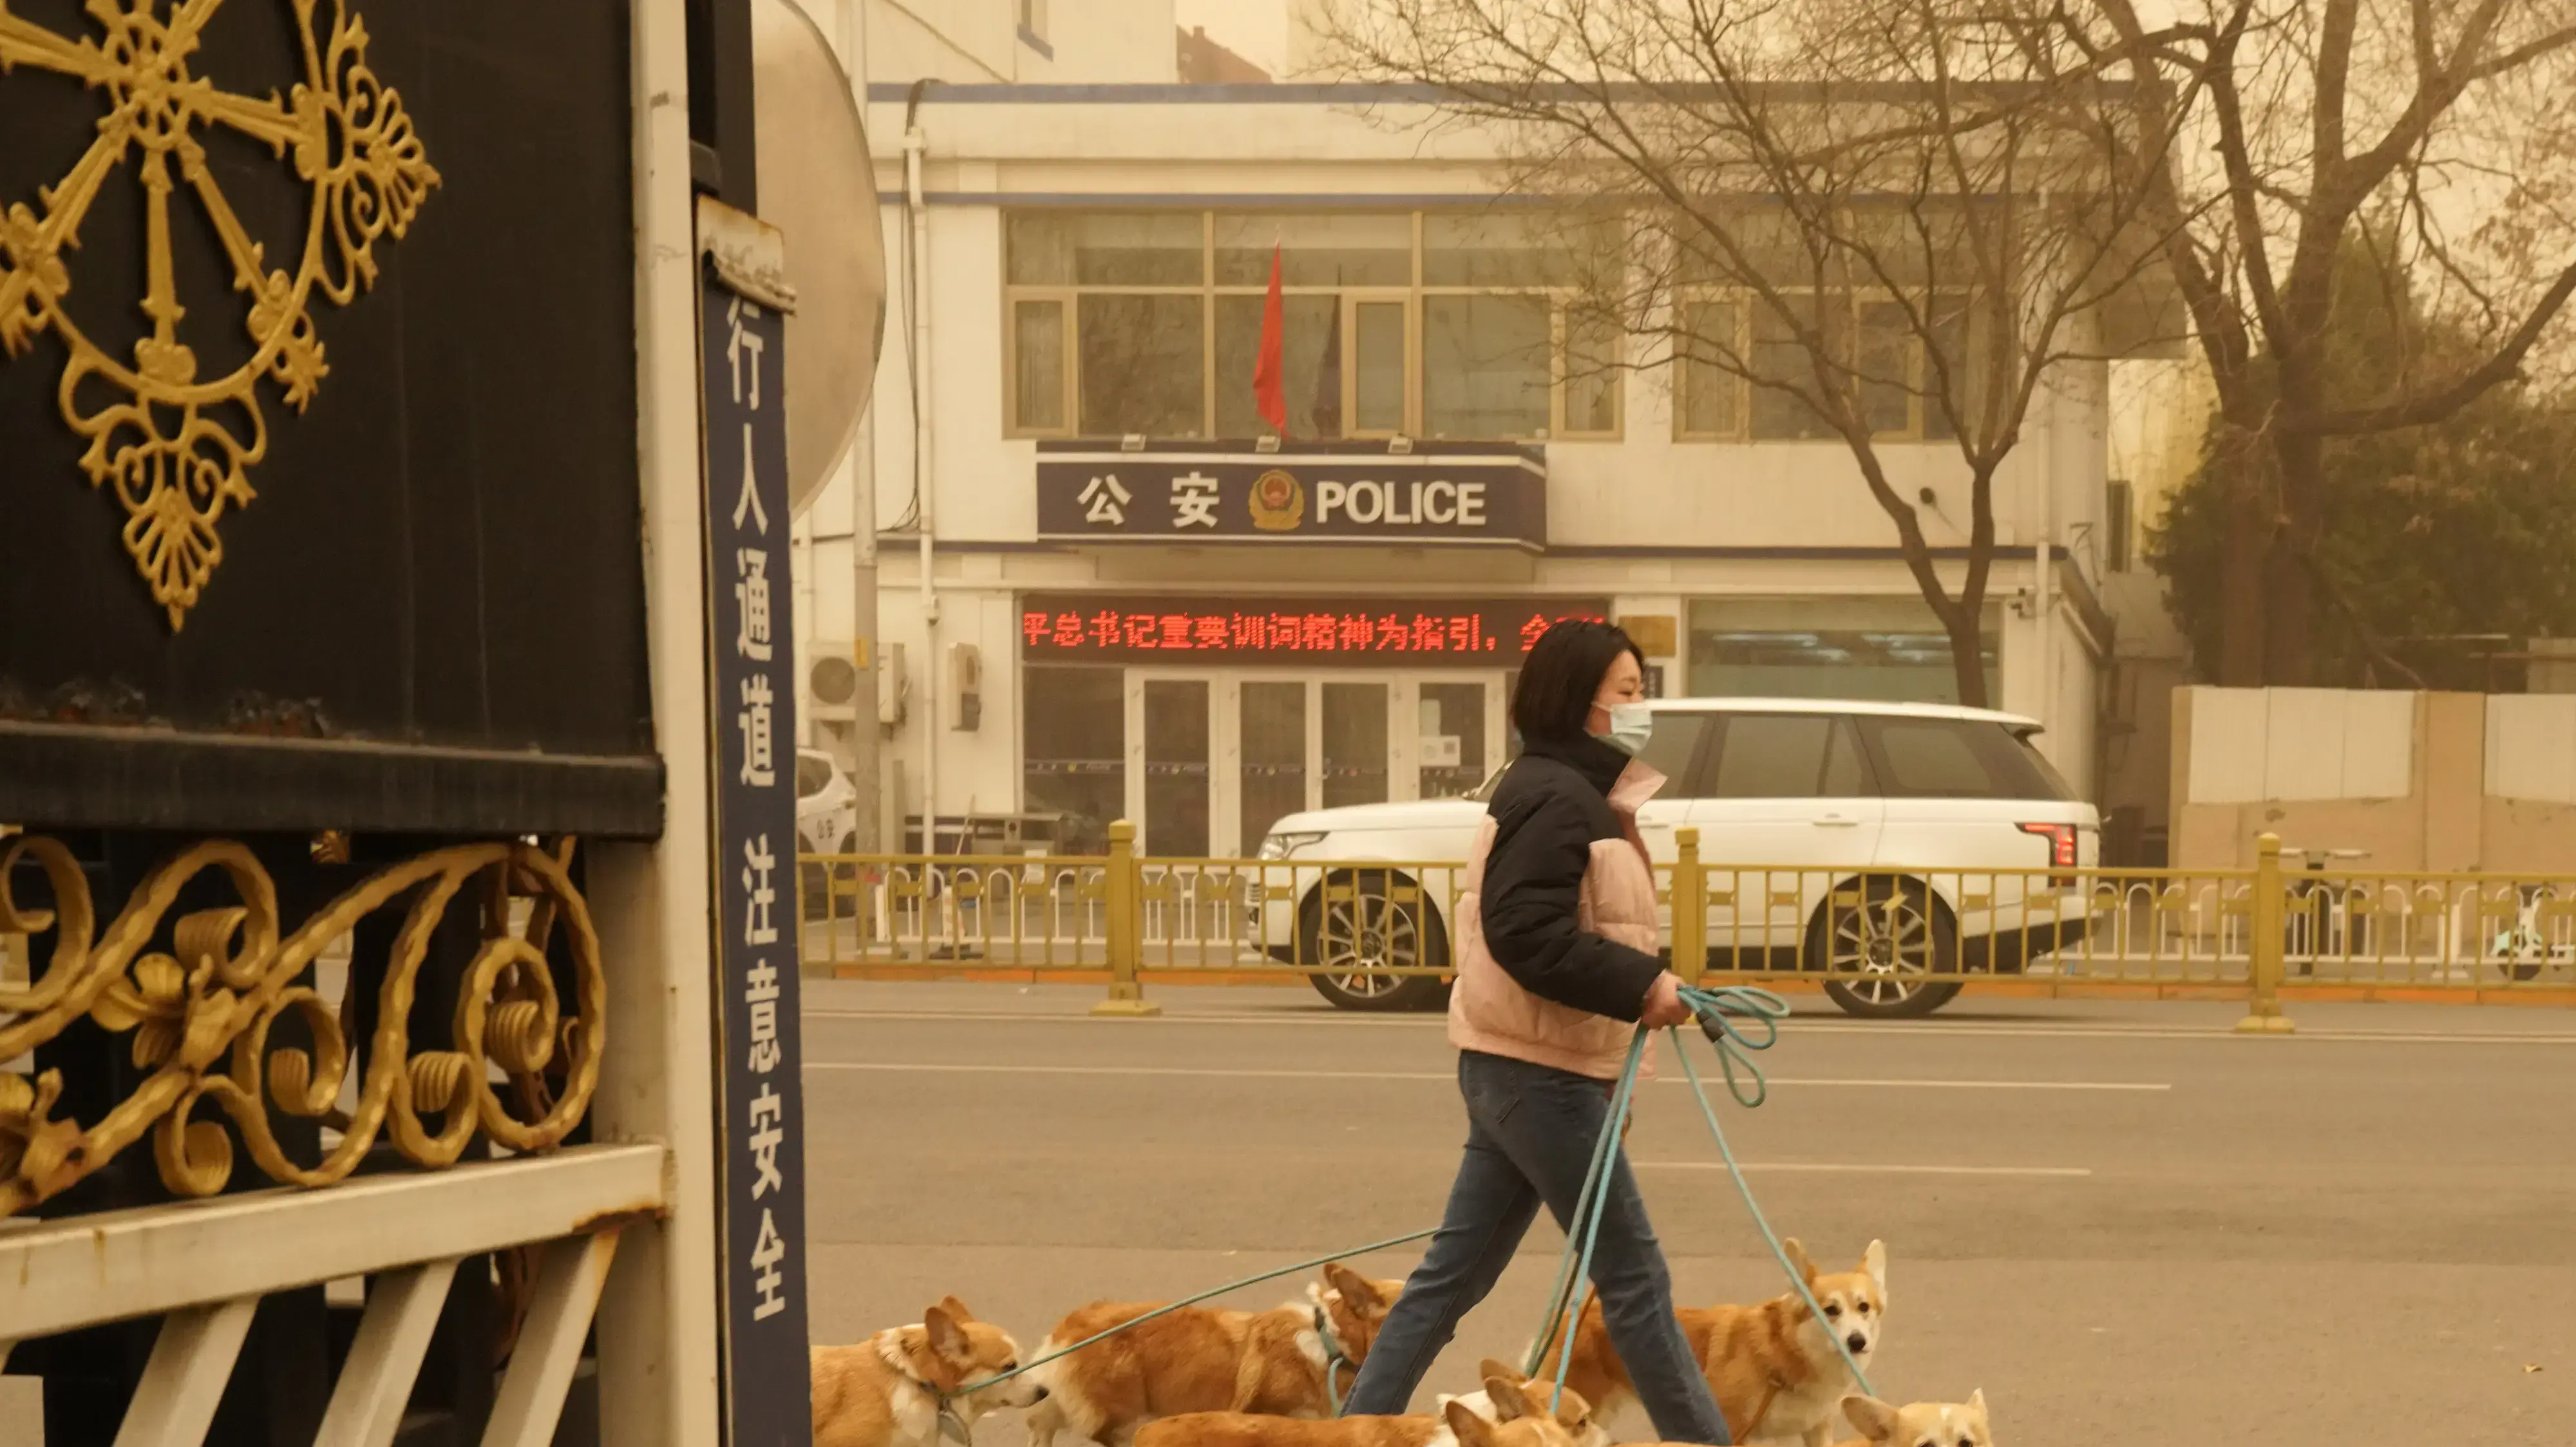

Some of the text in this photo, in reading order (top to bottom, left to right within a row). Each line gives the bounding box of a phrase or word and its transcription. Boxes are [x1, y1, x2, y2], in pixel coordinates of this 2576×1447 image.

[1077, 471, 1486, 527] 公安 POLICE
[726, 296, 784, 1321] 行人通道 注意安全
